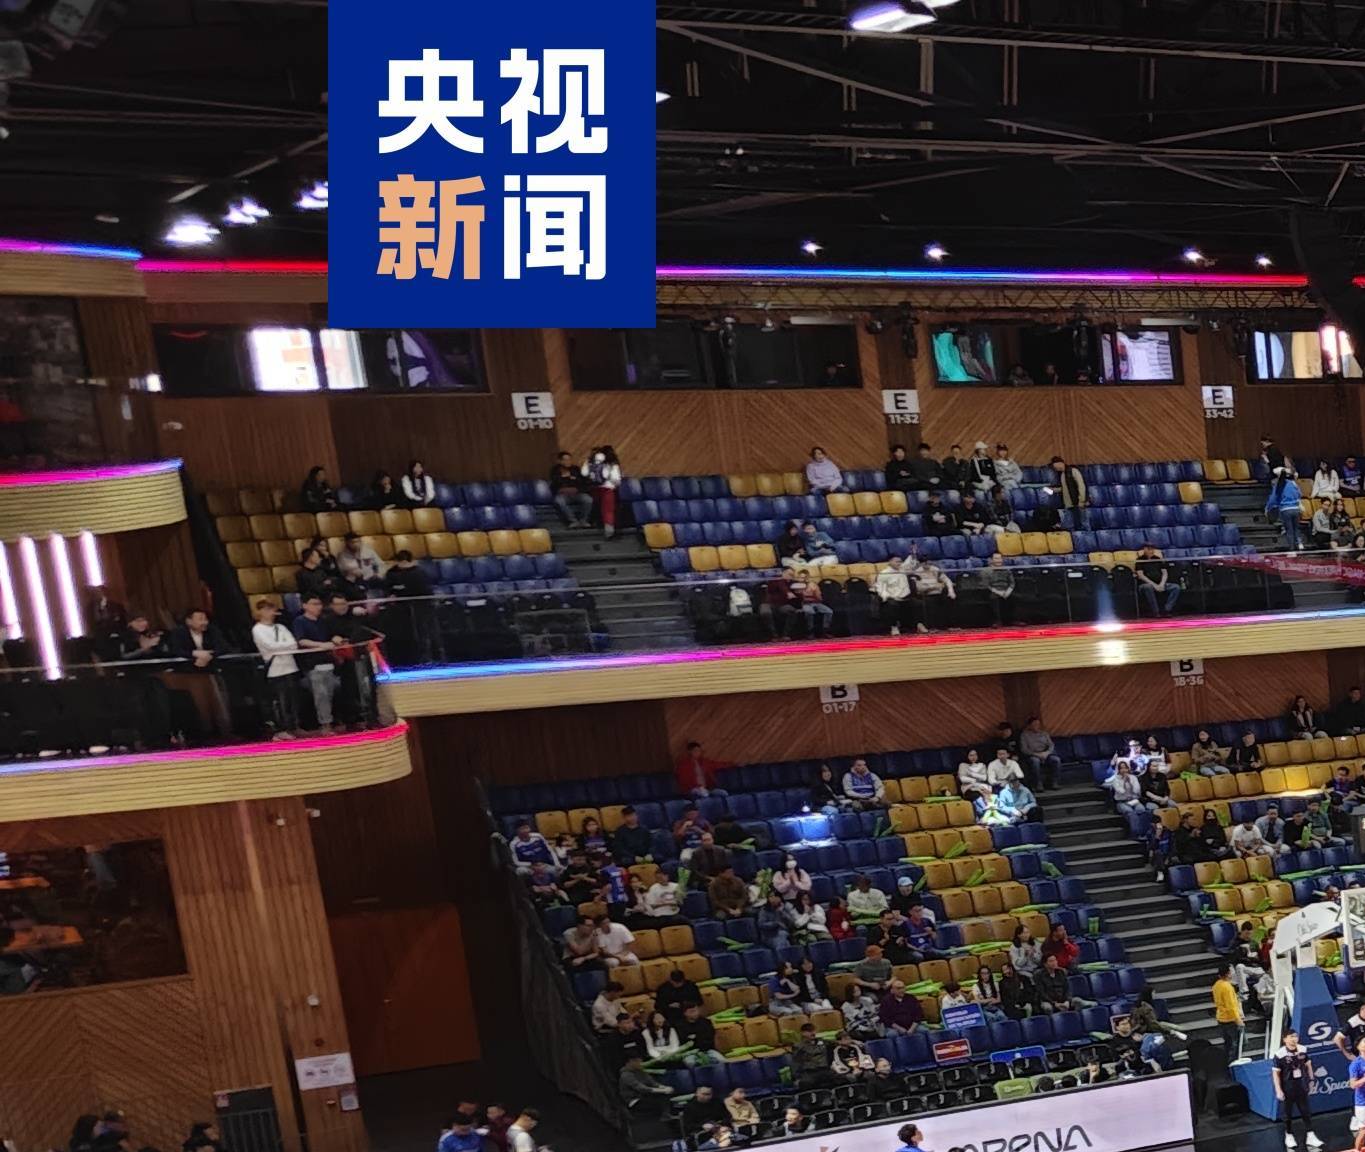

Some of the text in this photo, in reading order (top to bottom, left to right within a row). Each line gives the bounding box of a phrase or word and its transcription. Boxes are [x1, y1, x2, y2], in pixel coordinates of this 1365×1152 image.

[525, 395, 541, 415] E
[893, 392, 909, 410] E
[1211, 388, 1225, 406] E
